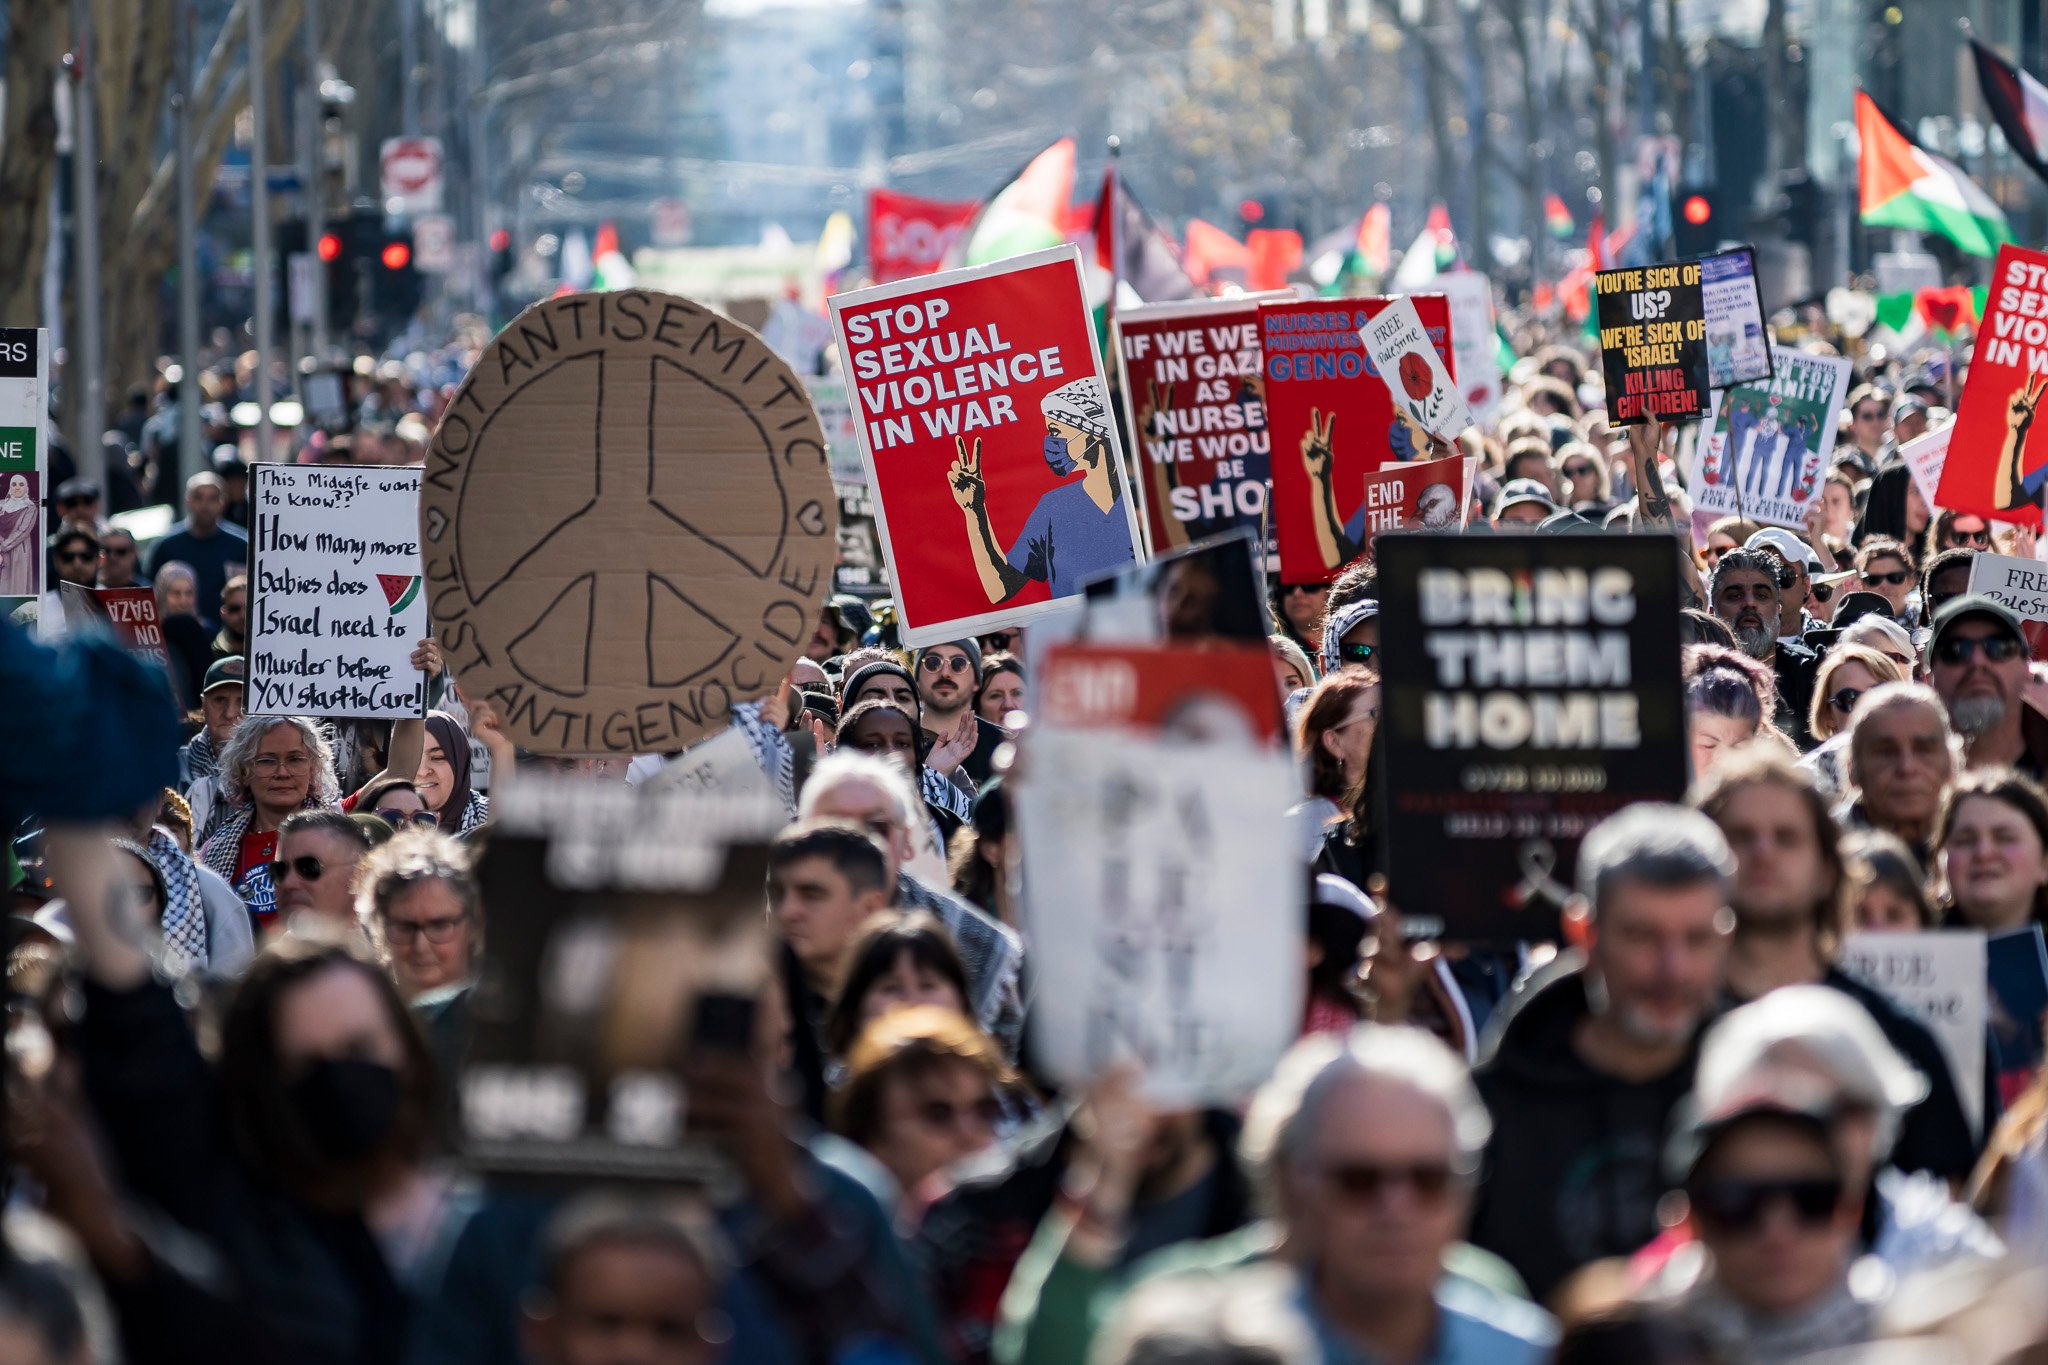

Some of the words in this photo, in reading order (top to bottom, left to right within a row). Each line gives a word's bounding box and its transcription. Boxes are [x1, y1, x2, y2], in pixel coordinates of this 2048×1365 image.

[1596, 270, 1643, 295] YOU'RE
[1646, 265, 1680, 289] SICK
[1683, 264, 1702, 286] OF
[847, 297, 951, 345] STOP
[1632, 290, 1672, 321] US?
[1265, 311, 1351, 334] NURSES
[1354, 310, 1370, 328] &
[1372, 313, 1404, 346] FREE
[1601, 324, 1644, 350] WE'RE
[1647, 321, 1683, 345] SICK
[1687, 319, 1706, 341] OF
[1995, 310, 2048, 345] VIO
[854, 323, 1012, 380] SEXUAL
[1124, 334, 1150, 360] IF
[1154, 328, 1206, 357] WE
[1266, 331, 1361, 351] MIDWIVES
[1624, 342, 1682, 368] 'ISRAEL'
[1985, 337, 2022, 368] IN
[860, 346, 1064, 415] VIOLENCE
[1154, 357, 1190, 384] IN
[1624, 368, 1685, 395] KILLING
[427, 379, 486, 492] NOT
[499, 291, 826, 467] ANTISEMITIC
[1195, 379, 1231, 403] AS
[1617, 389, 1699, 419] CHILDREN!
[1742, 379, 1832, 404] MANITY
[869, 414, 915, 451] IN
[920, 394, 1019, 439] WAR
[1153, 401, 1267, 436] NURSE
[1145, 438, 1195, 464] WE
[1196, 431, 1271, 460] WOU
[258, 469, 296, 487] This
[308, 472, 370, 496] Midwife
[1216, 459, 1245, 480] BE
[261, 489, 280, 506] to
[1169, 479, 1273, 522] SHO
[1368, 480, 1404, 508] END
[1700, 495, 1725, 509] FOR
[1367, 507, 1404, 533] THE
[258, 513, 310, 553] How
[316, 532, 366, 565] many
[370, 540, 421, 556] more
[258, 559, 322, 596] babies
[327, 569, 368, 596] does
[106, 599, 155, 622] GAZA
[255, 595, 323, 638] Israel
[330, 615, 380, 638] need
[383, 616, 407, 638] to
[133, 625, 161, 646] ON
[337, 655, 393, 682] before
[426, 557, 492, 676] JUST
[486, 556, 819, 752] ANTIGENOCIDE
[1425, 631, 1633, 688] THEM
[252, 677, 294, 713] YOU
[1424, 691, 1641, 751] HOME
